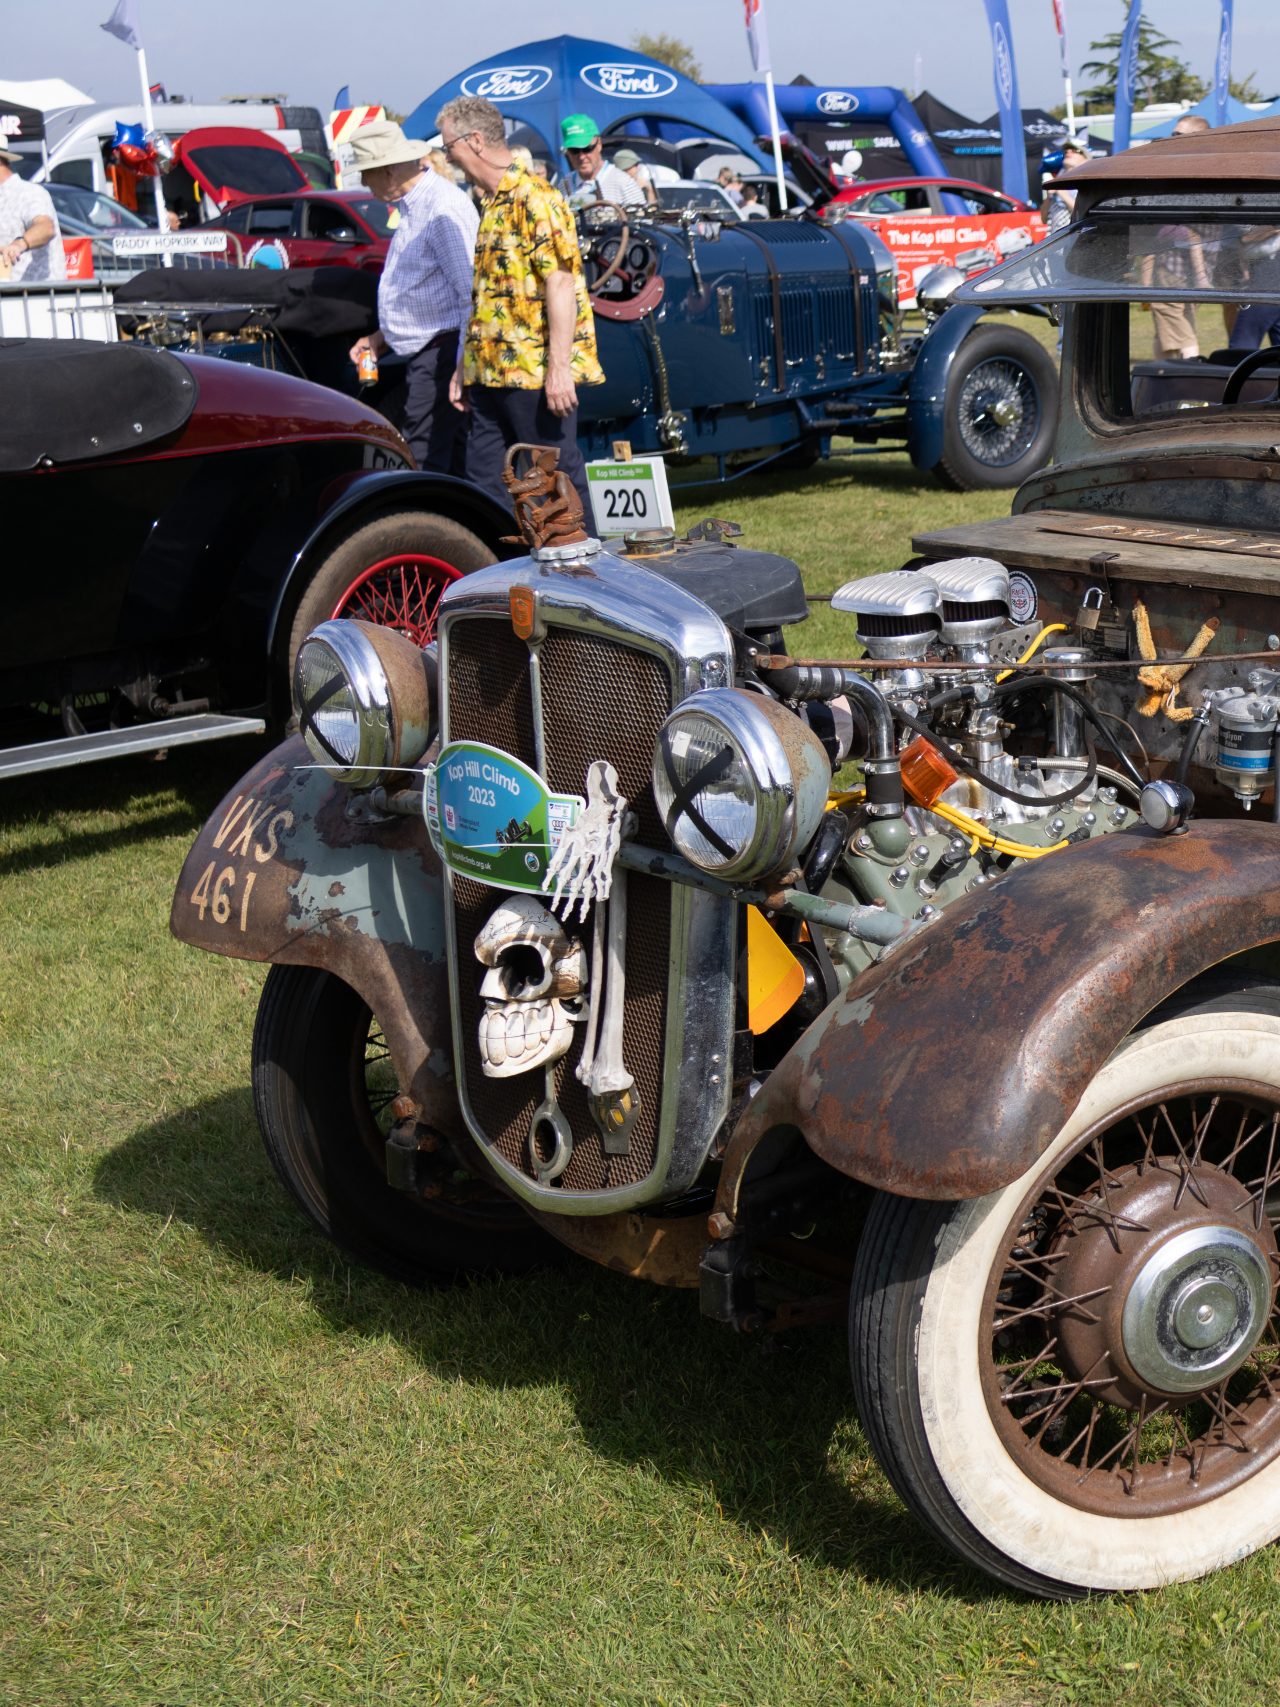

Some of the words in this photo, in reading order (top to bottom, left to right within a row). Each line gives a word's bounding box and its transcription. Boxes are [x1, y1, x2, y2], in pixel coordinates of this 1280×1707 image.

[477, 69, 539, 96] Ford
[598, 67, 659, 93] Ford
[823, 94, 851, 112] Ford
[115, 238, 150, 249] PADDY
[155, 237, 200, 248] HOPKIRK
[203, 235, 225, 246] WAY
[887, 229, 910, 245] The
[911, 229, 935, 248] Kop
[935, 228, 956, 244] Hill
[956, 227, 988, 242] Climb
[596, 469, 609, 478] Kop
[609, 469, 618, 477] Hill
[618, 468, 635, 476] Climb
[603, 488, 647, 518] 220
[447, 764, 464, 782] Kop
[464, 760, 481, 778] Hill
[482, 764, 521, 796] Climb
[468, 784, 497, 807] 2023
[212, 795, 294, 863] VXS
[190, 860, 257, 932] 461
